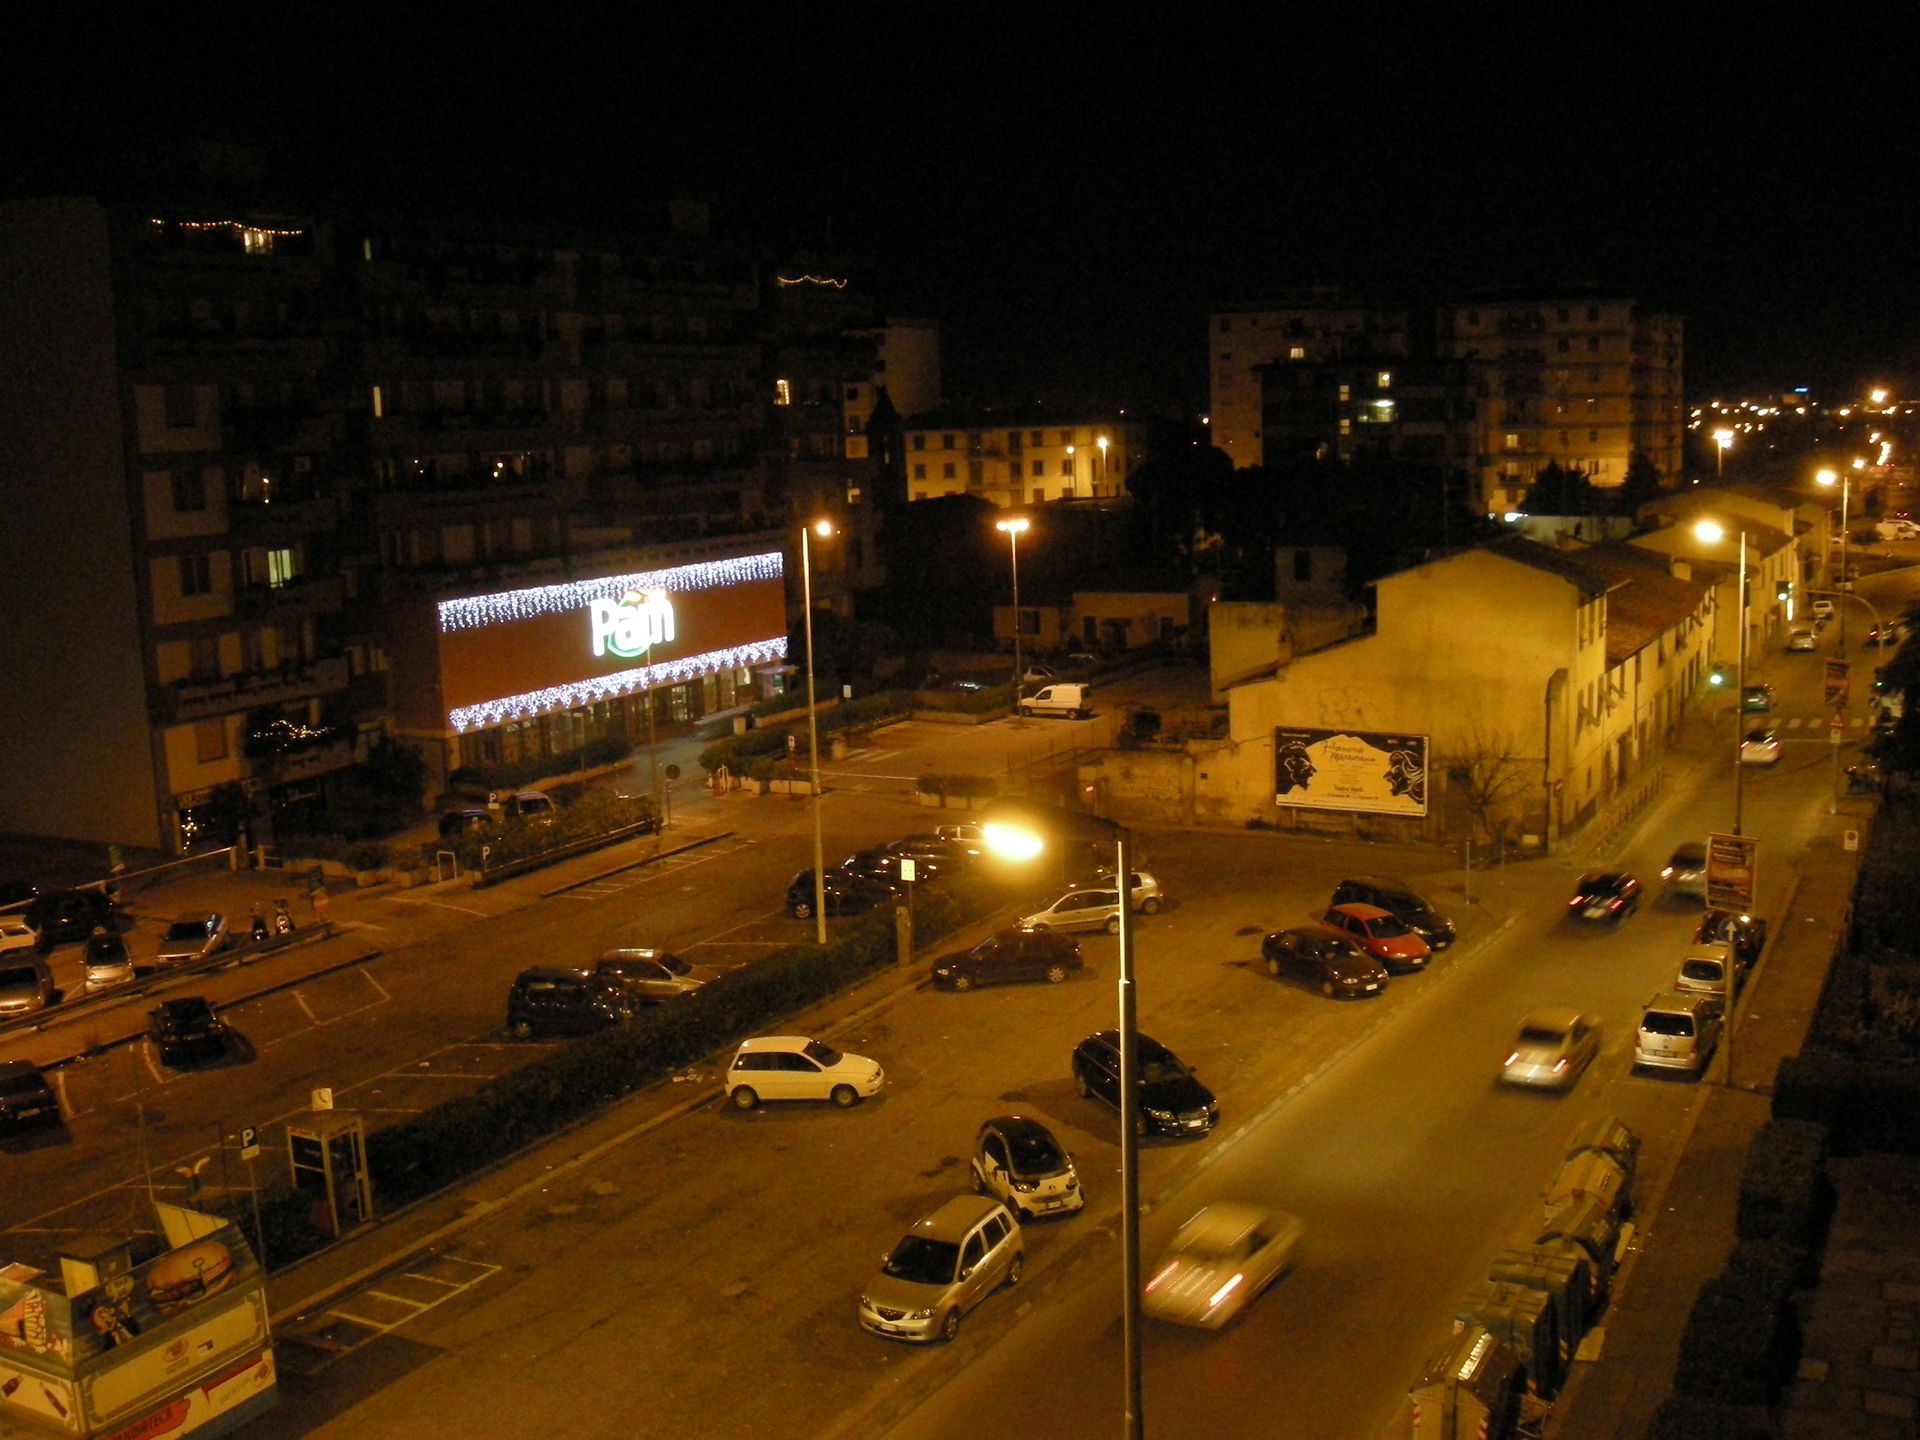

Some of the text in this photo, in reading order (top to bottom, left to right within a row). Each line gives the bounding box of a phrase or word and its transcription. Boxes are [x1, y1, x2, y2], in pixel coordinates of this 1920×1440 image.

[590, 598, 675, 657] Pam
[489, 792, 497, 802] P
[482, 846, 490, 860] P
[242, 1129, 254, 1147] P
